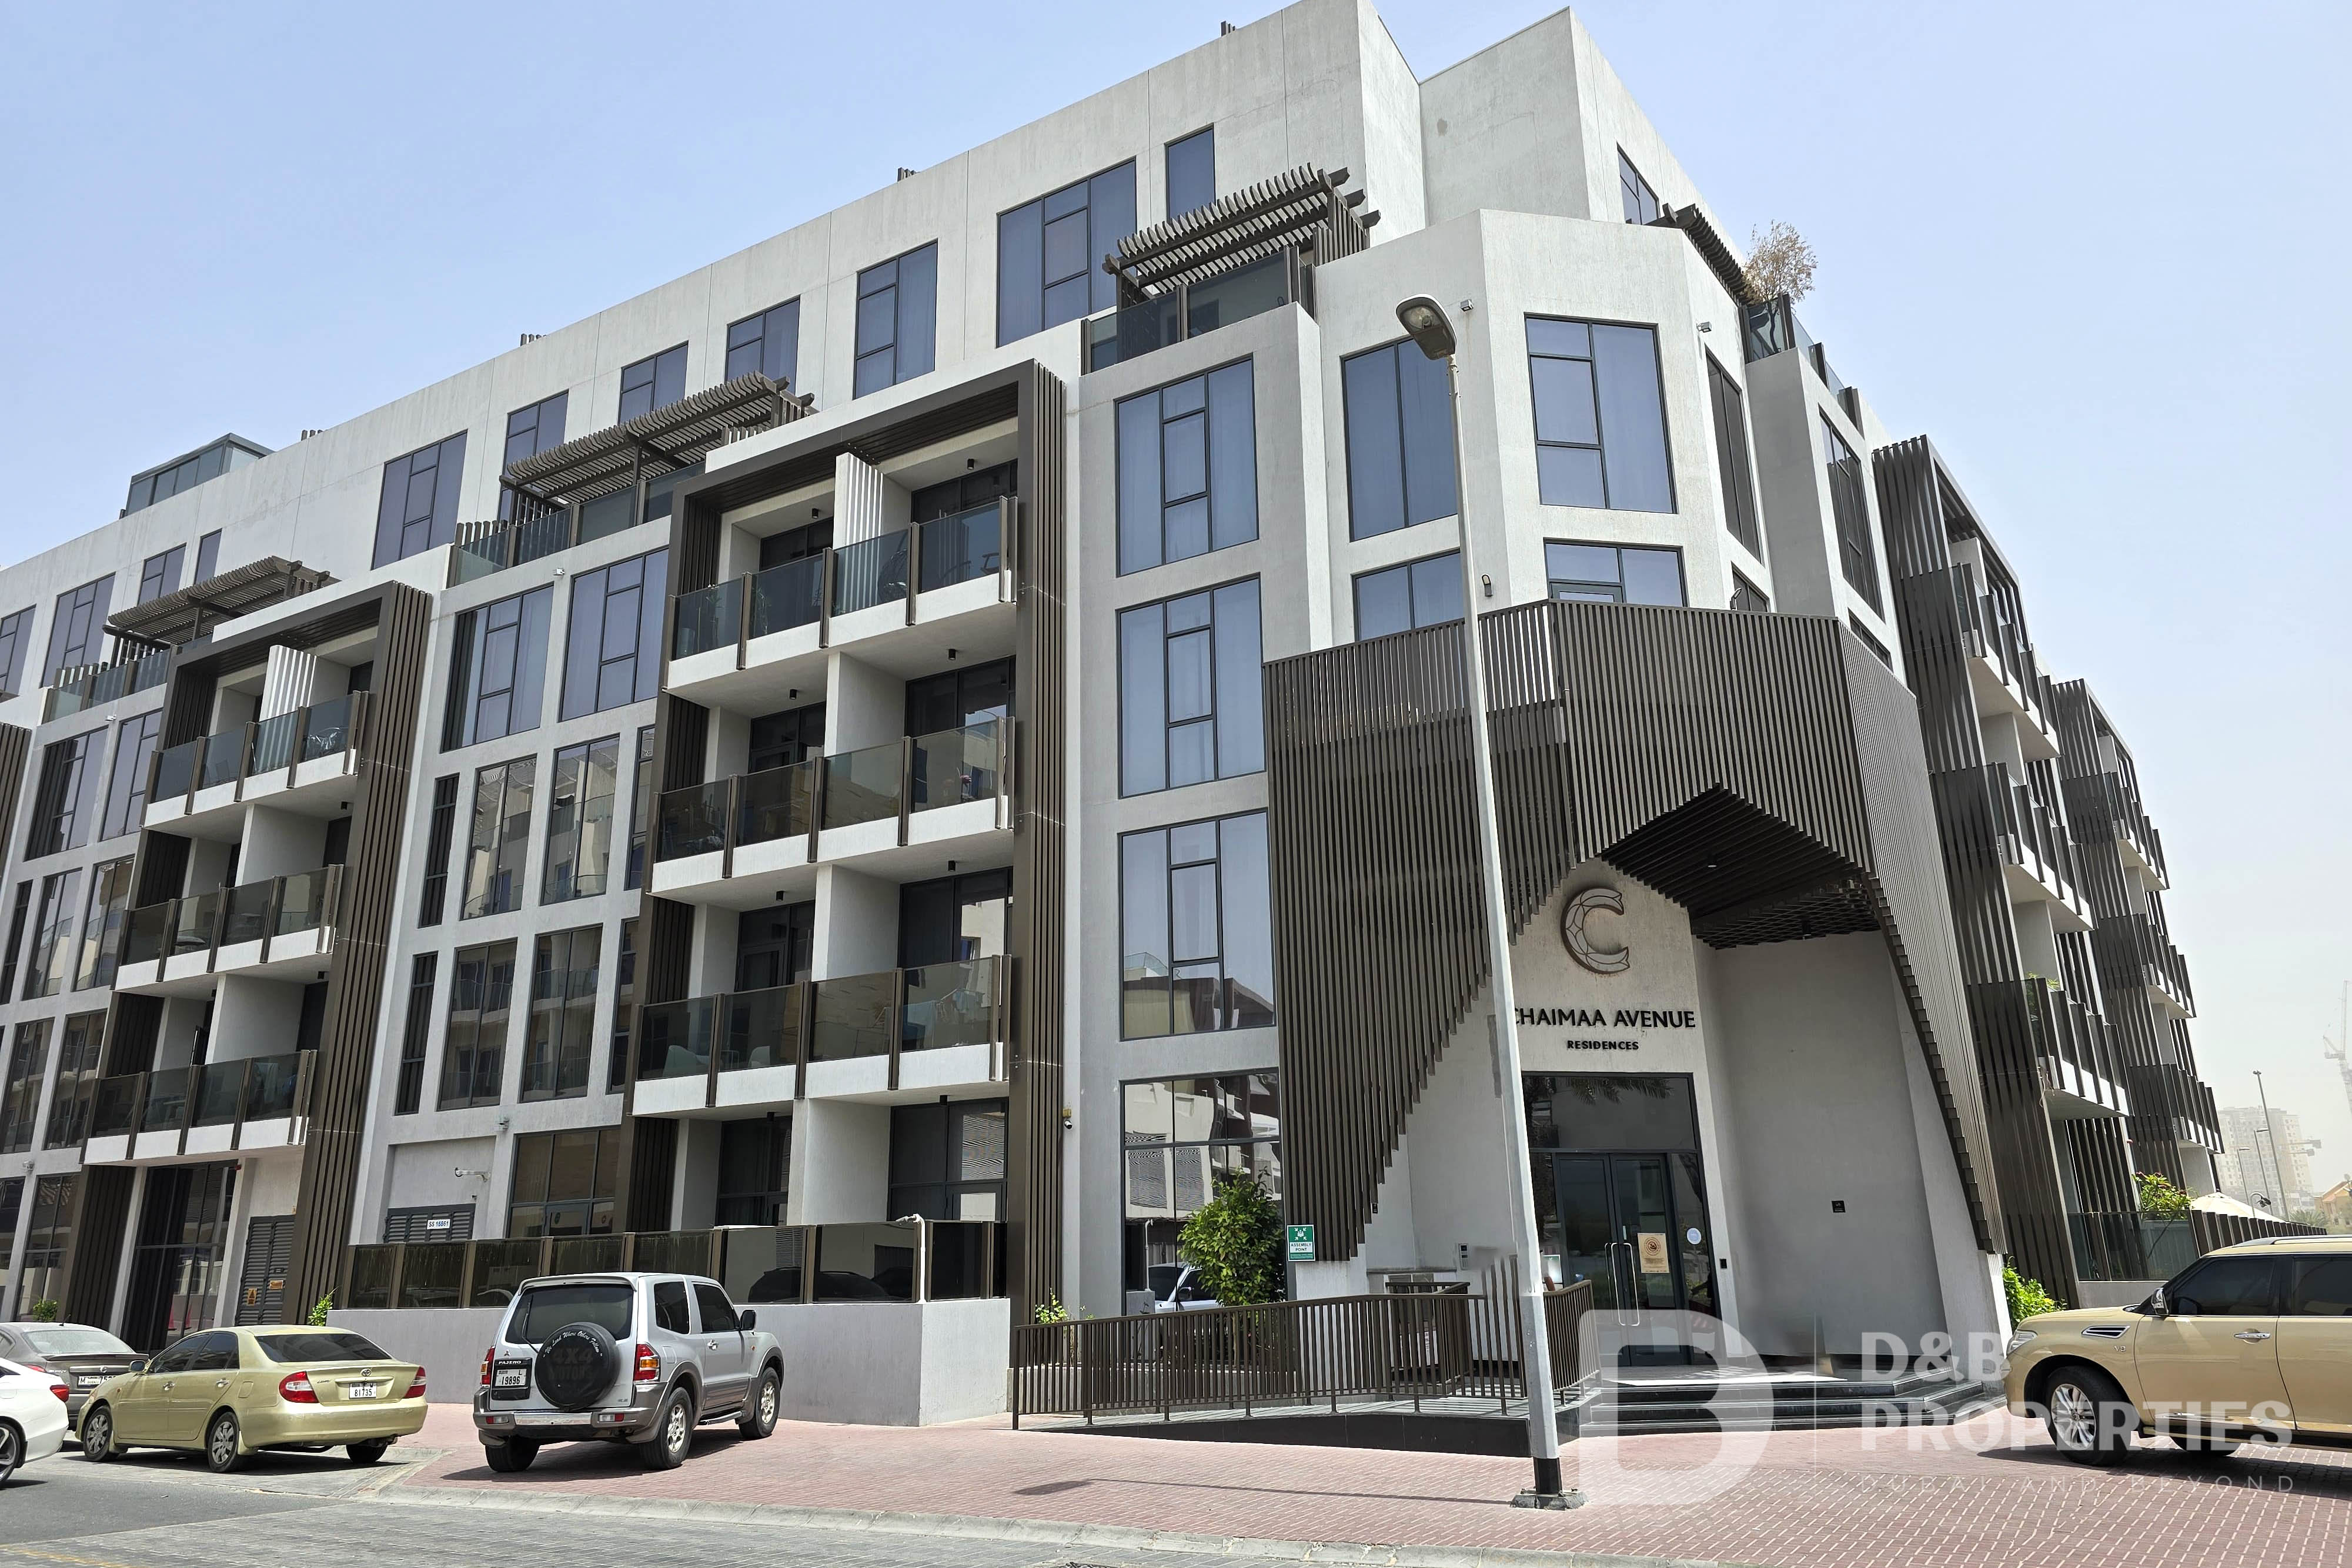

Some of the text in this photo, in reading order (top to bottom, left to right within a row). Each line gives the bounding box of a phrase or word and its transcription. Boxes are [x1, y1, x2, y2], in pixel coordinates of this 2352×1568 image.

[1613, 1009, 1696, 1028] AVENUE
[1567, 1039, 1639, 1051] RESIDENCES
[577, 1330, 590, 1340] Others
[502, 1376, 520, 1385] 19896
[354, 1389, 372, 1397] 81735
